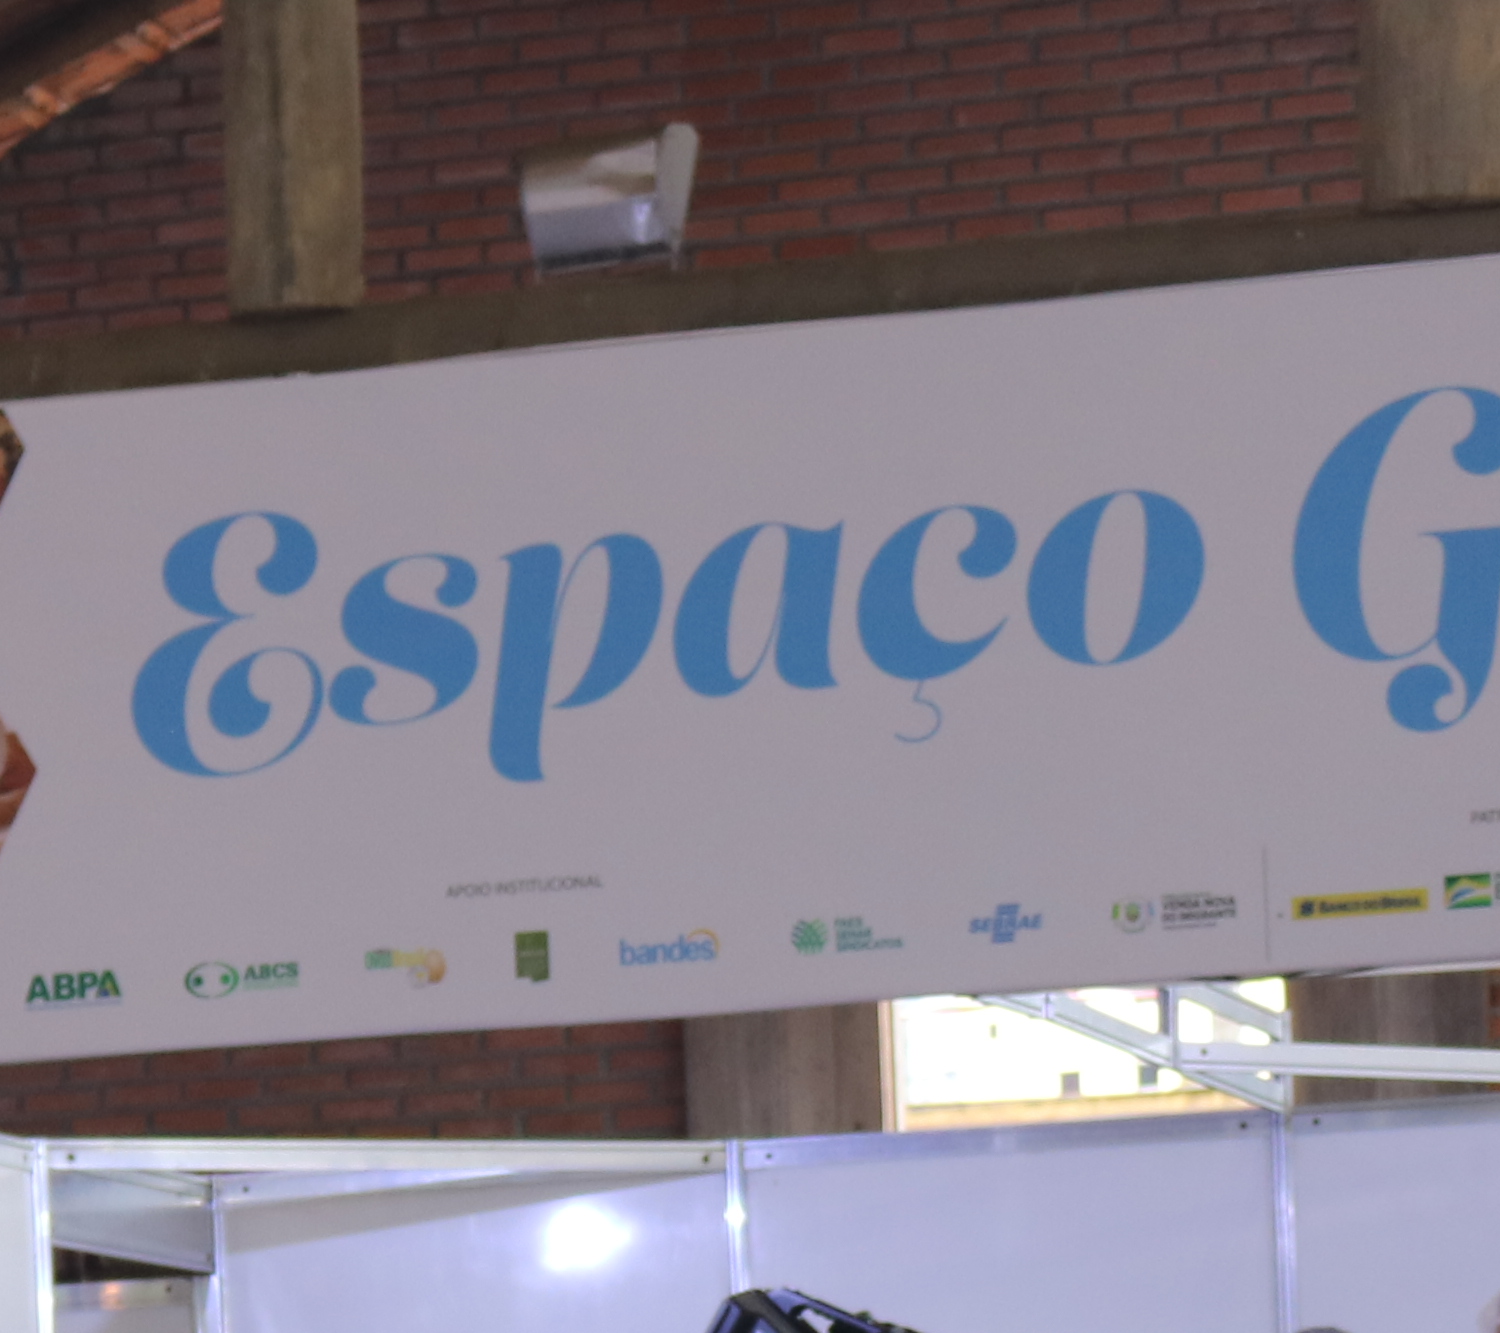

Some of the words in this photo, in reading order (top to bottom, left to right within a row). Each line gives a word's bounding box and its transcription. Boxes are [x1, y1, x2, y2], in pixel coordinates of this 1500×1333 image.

[131, 489, 1208, 785] Espaço
[446, 881, 491, 899] APOIO
[494, 875, 603, 895] INSTITUCIONAL
[619, 934, 716, 966] bandes
[26, 970, 121, 1003] ABPA
[243, 963, 298, 981] ABCS
